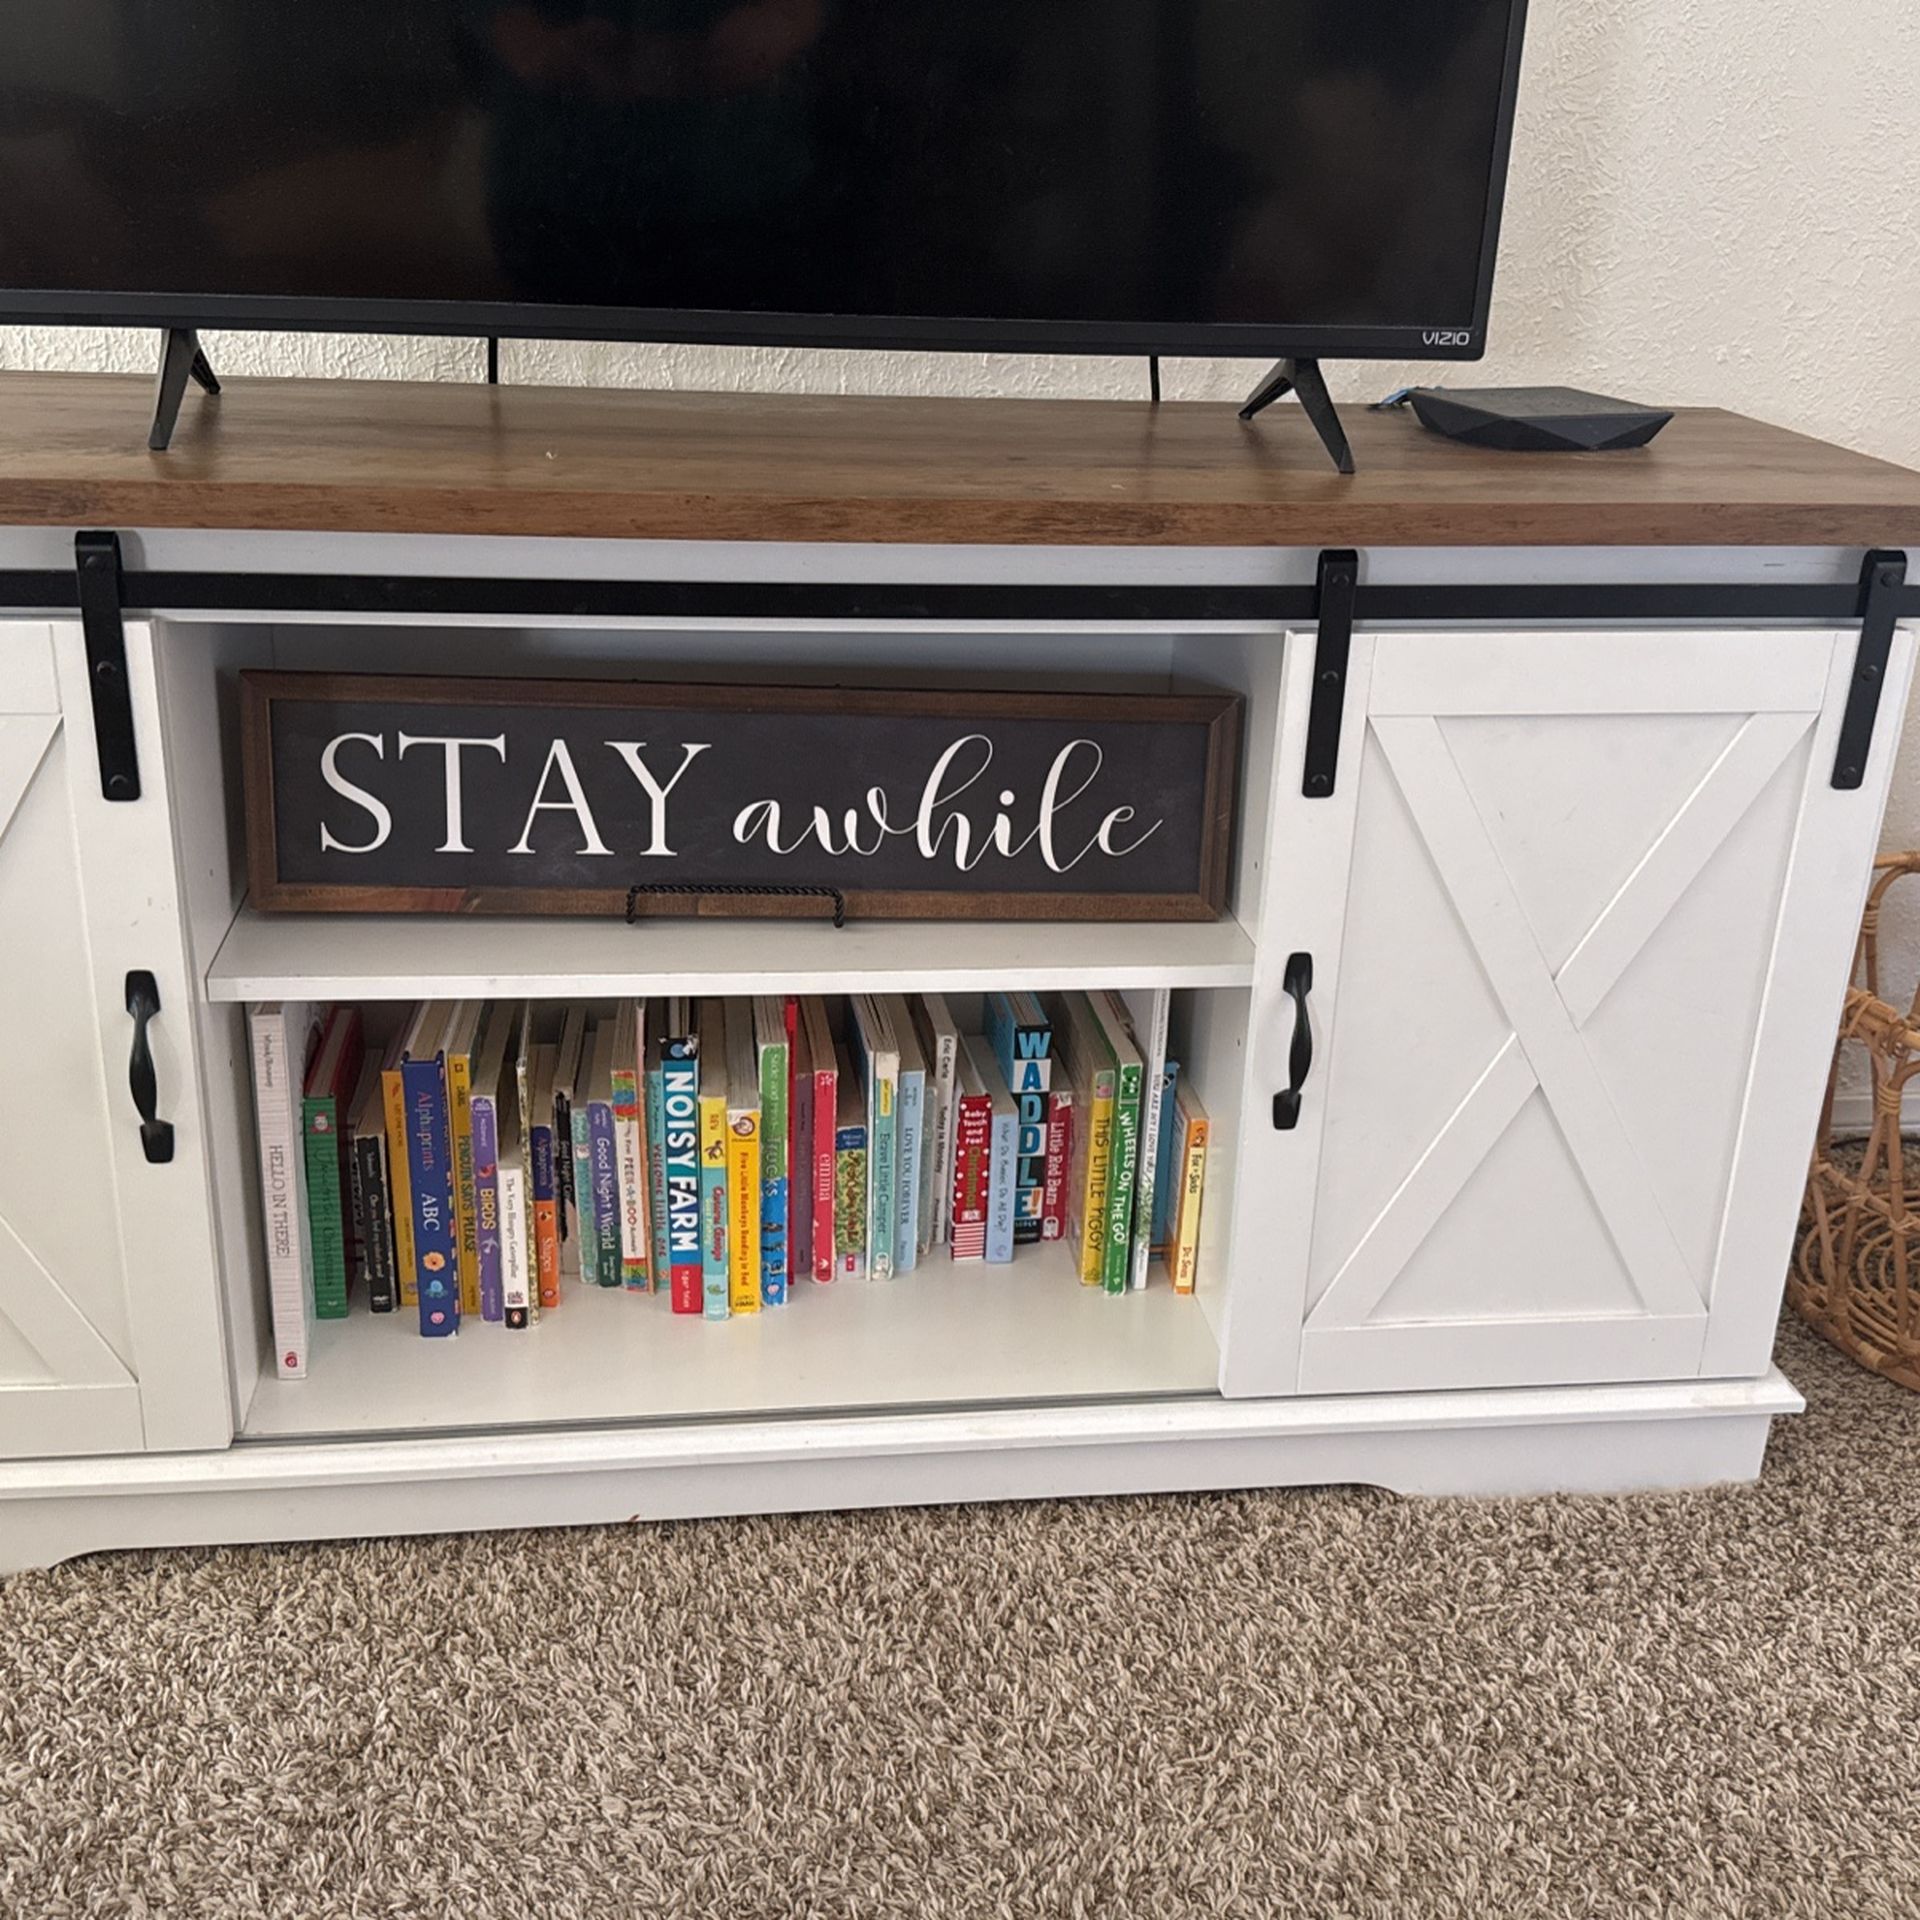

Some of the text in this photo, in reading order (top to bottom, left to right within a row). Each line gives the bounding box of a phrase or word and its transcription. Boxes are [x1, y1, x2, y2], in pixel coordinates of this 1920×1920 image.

[1422, 331, 1470, 346] VIZIO
[319, 731, 1162, 875] STAY awhile
[941, 1038, 952, 1079] Eric Carle
[769, 1079, 780, 1101] and
[1153, 1073, 1161, 1091] YOU
[964, 1109, 986, 1119] Baby
[1151, 1093, 1159, 1111] ARE
[936, 1105, 948, 1130] Today
[963, 1119, 988, 1128] Touch
[1014, 1031, 1052, 1218] WADDLE!
[1149, 1112, 1157, 1126] MY
[415, 1090, 437, 1171] Alphaprints
[966, 1127, 983, 1136] and
[966, 1136, 983, 1145] Feel
[1001, 1121, 1010, 1143] What
[1119, 1111, 1136, 1169] WHEELS
[561, 1140, 570, 1160] Good
[597, 1137, 610, 1169] Good
[1000, 1144, 1010, 1157] Do
[1146, 1133, 1156, 1154] LOVE
[459, 1135, 474, 1181] PENGUIN
[664, 1071, 698, 1251] NOISY FARM
[740, 1152, 749, 1169] Five
[765, 1136, 784, 1197] Trucks
[934, 1141, 946, 1174] Monday
[1046, 1121, 1065, 1206] Little Red Barn
[1190, 1153, 1203, 1168] Fox
[562, 1160, 572, 1183] Night
[740, 1170, 749, 1192] Little
[818, 1152, 833, 1202] emma
[876, 1132, 891, 1234] Brave Little Camper
[900, 1127, 914, 1225] LOVE YOU FOREVER
[1116, 1170, 1132, 1192] ON
[1188, 1173, 1201, 1195] Socks
[461, 1183, 476, 1210] SAYS
[505, 1177, 515, 1192] The
[598, 1172, 613, 1209] Night
[998, 1187, 1009, 1199] Do
[1088, 1117, 1110, 1253] THIS LITTLE PIGGY
[269, 1146, 290, 1256] HELLO IN THERE
[420, 1192, 441, 1231] ABC
[480, 1187, 495, 1230] BIRDS
[506, 1192, 516, 1210] Very
[738, 1192, 750, 1228] Monkeys
[997, 1200, 1008, 1212] All
[1110, 1195, 1126, 1221] THE
[507, 1211, 518, 1240] Hungry
[599, 1212, 615, 1250] World
[710, 1186, 725, 1262] Curious George
[993, 1213, 1007, 1233] Day?
[540, 1236, 554, 1273] Shapes
[738, 1229, 750, 1262] Reading
[508, 1240, 519, 1279] Caterpillar
[740, 1262, 749, 1270] in
[1180, 1259, 1192, 1280] Seuss
[741, 1271, 750, 1286] Bed
